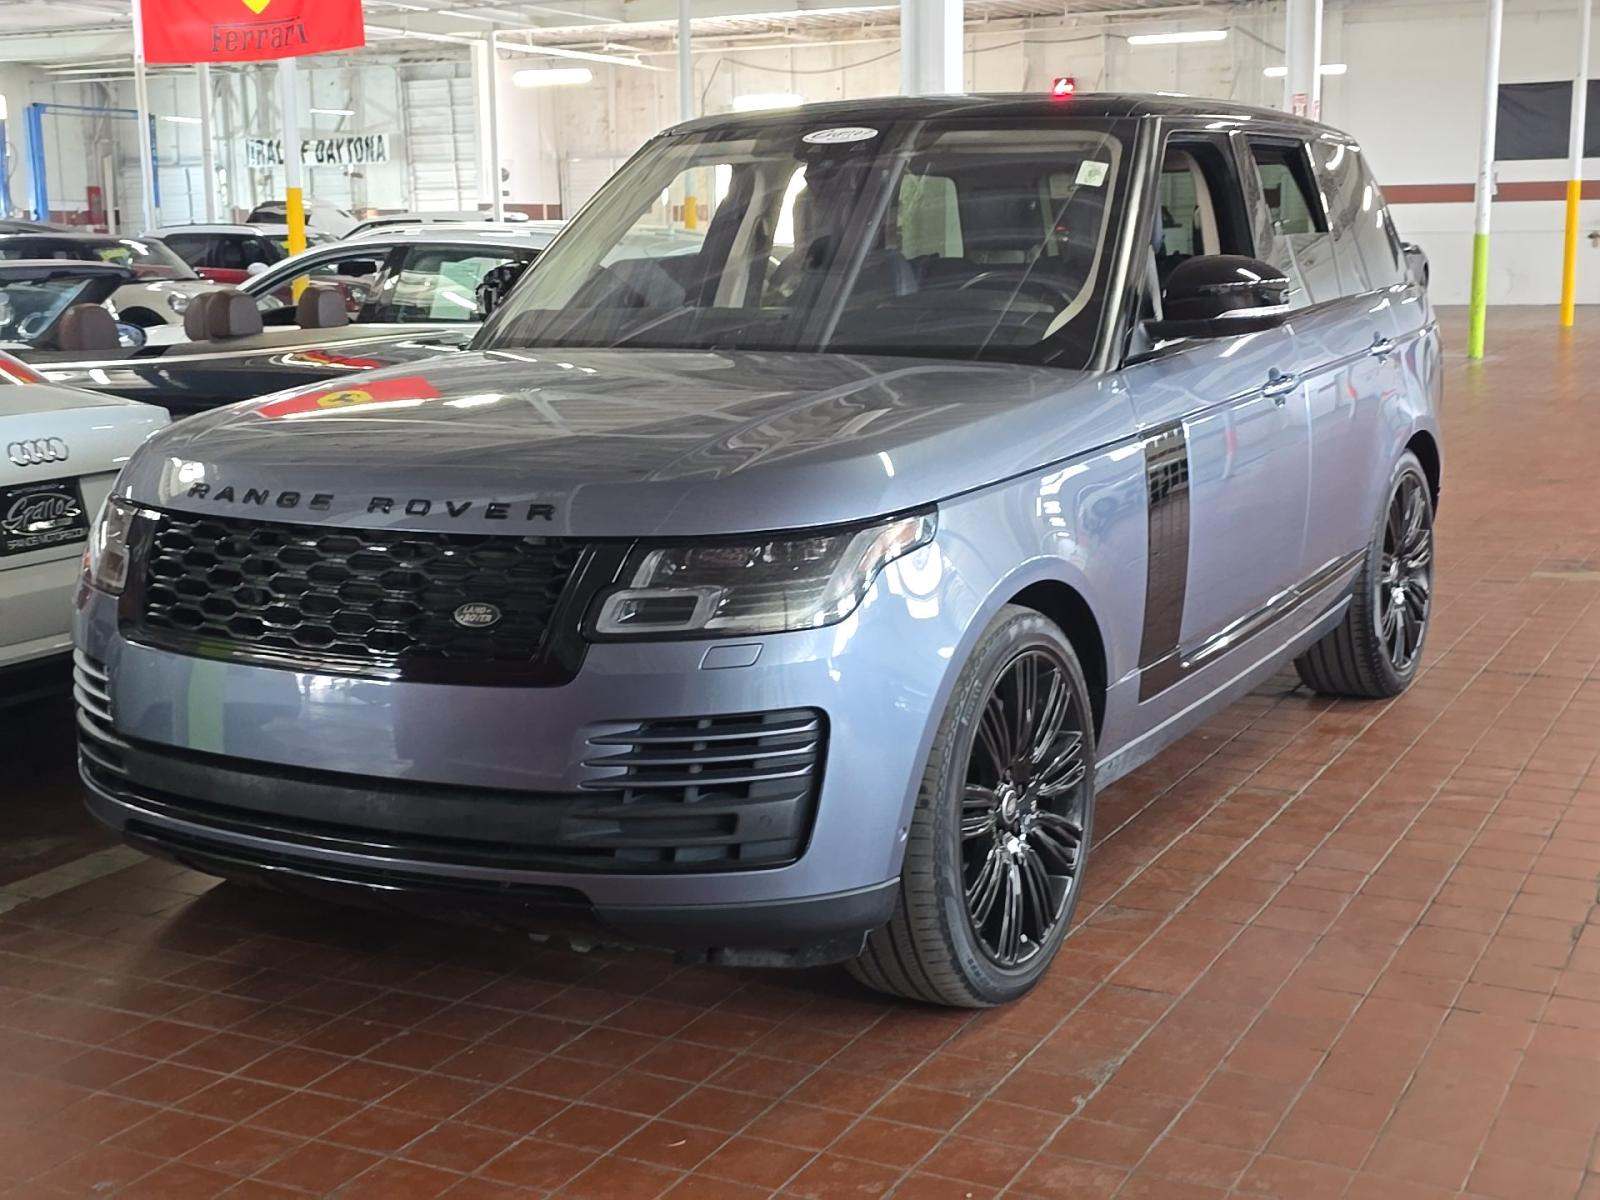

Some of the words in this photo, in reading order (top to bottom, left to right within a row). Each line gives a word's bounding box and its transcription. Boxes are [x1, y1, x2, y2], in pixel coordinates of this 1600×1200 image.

[211, 16, 308, 52] Ferrari
[315, 133, 386, 164] DAYTONA
[187, 482, 335, 512] RANGE
[367, 496, 556, 521] ROVER
